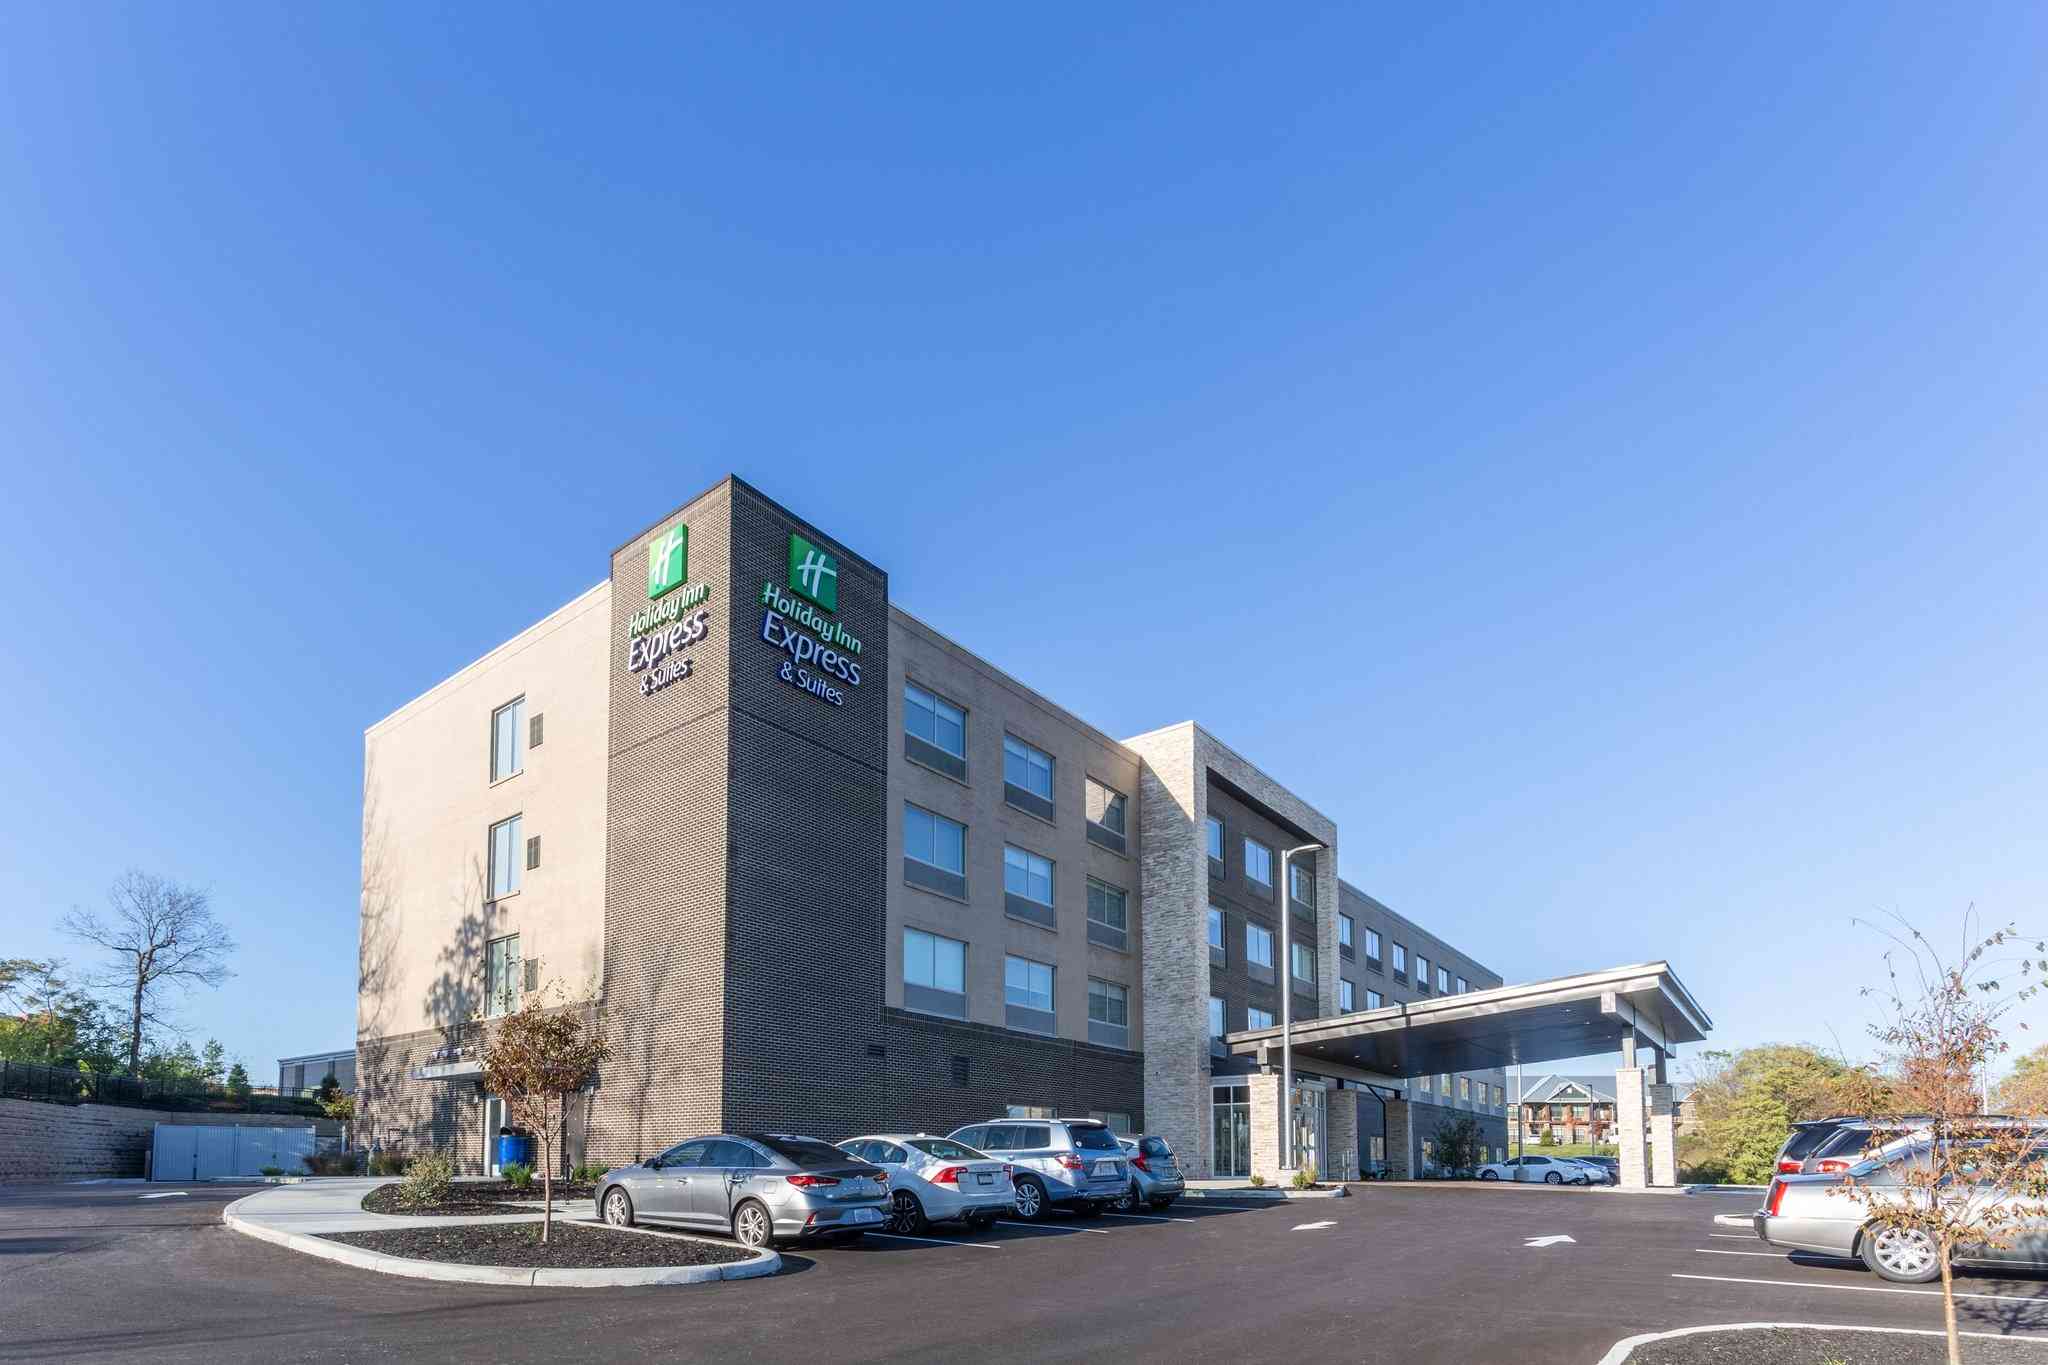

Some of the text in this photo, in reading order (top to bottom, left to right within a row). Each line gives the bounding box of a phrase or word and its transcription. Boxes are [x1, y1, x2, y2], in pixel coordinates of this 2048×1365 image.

[629, 583, 705, 637] Holiday Inn
[762, 582, 862, 654] Holiday Inn
[628, 609, 706, 671] Express
[762, 610, 861, 686] Express
[639, 660, 689, 693] & Suites
[780, 661, 843, 706] & Suites
